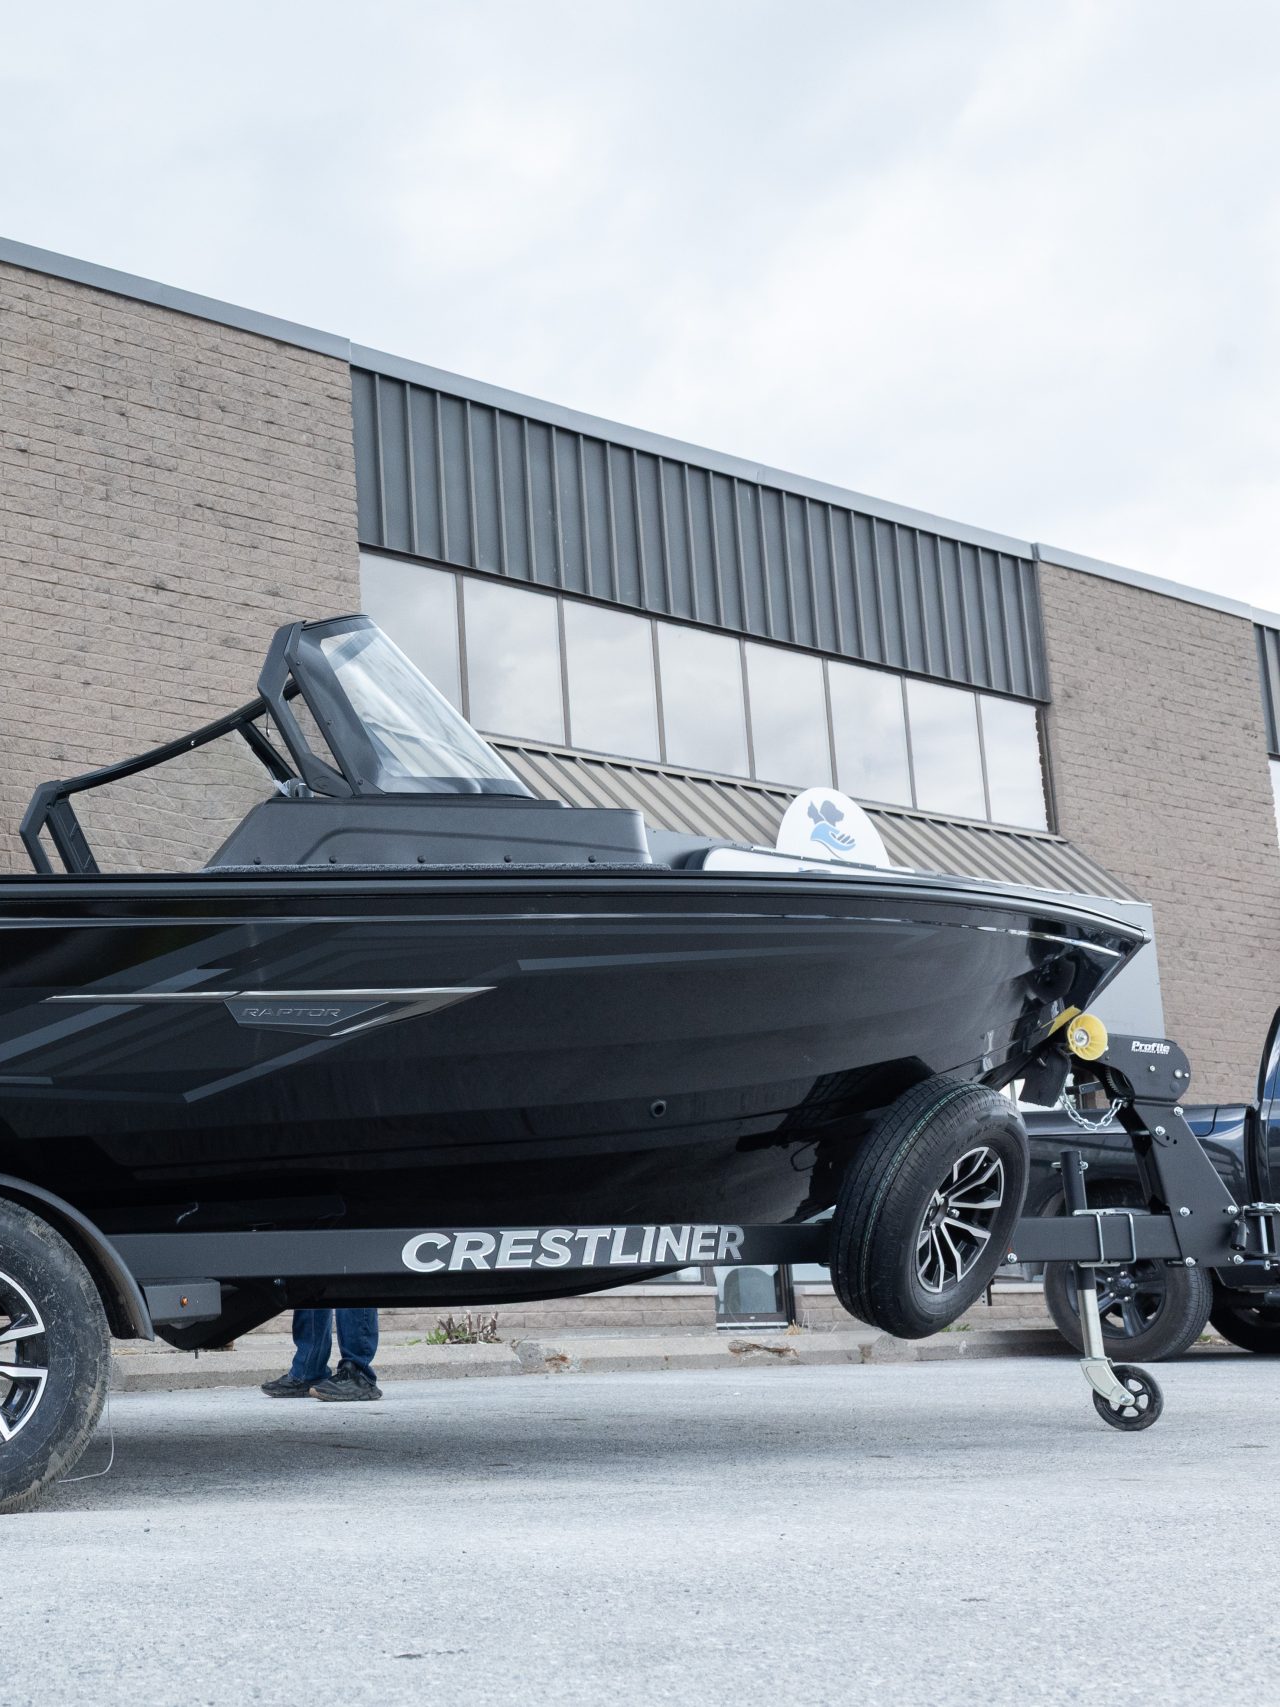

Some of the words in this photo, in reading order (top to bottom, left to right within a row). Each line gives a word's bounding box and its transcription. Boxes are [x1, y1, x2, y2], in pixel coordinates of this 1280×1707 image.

[240, 1008, 342, 1017] RAPTOR
[1131, 1040, 1170, 1053] Profile
[401, 1224, 745, 1272] CRESTLINER
